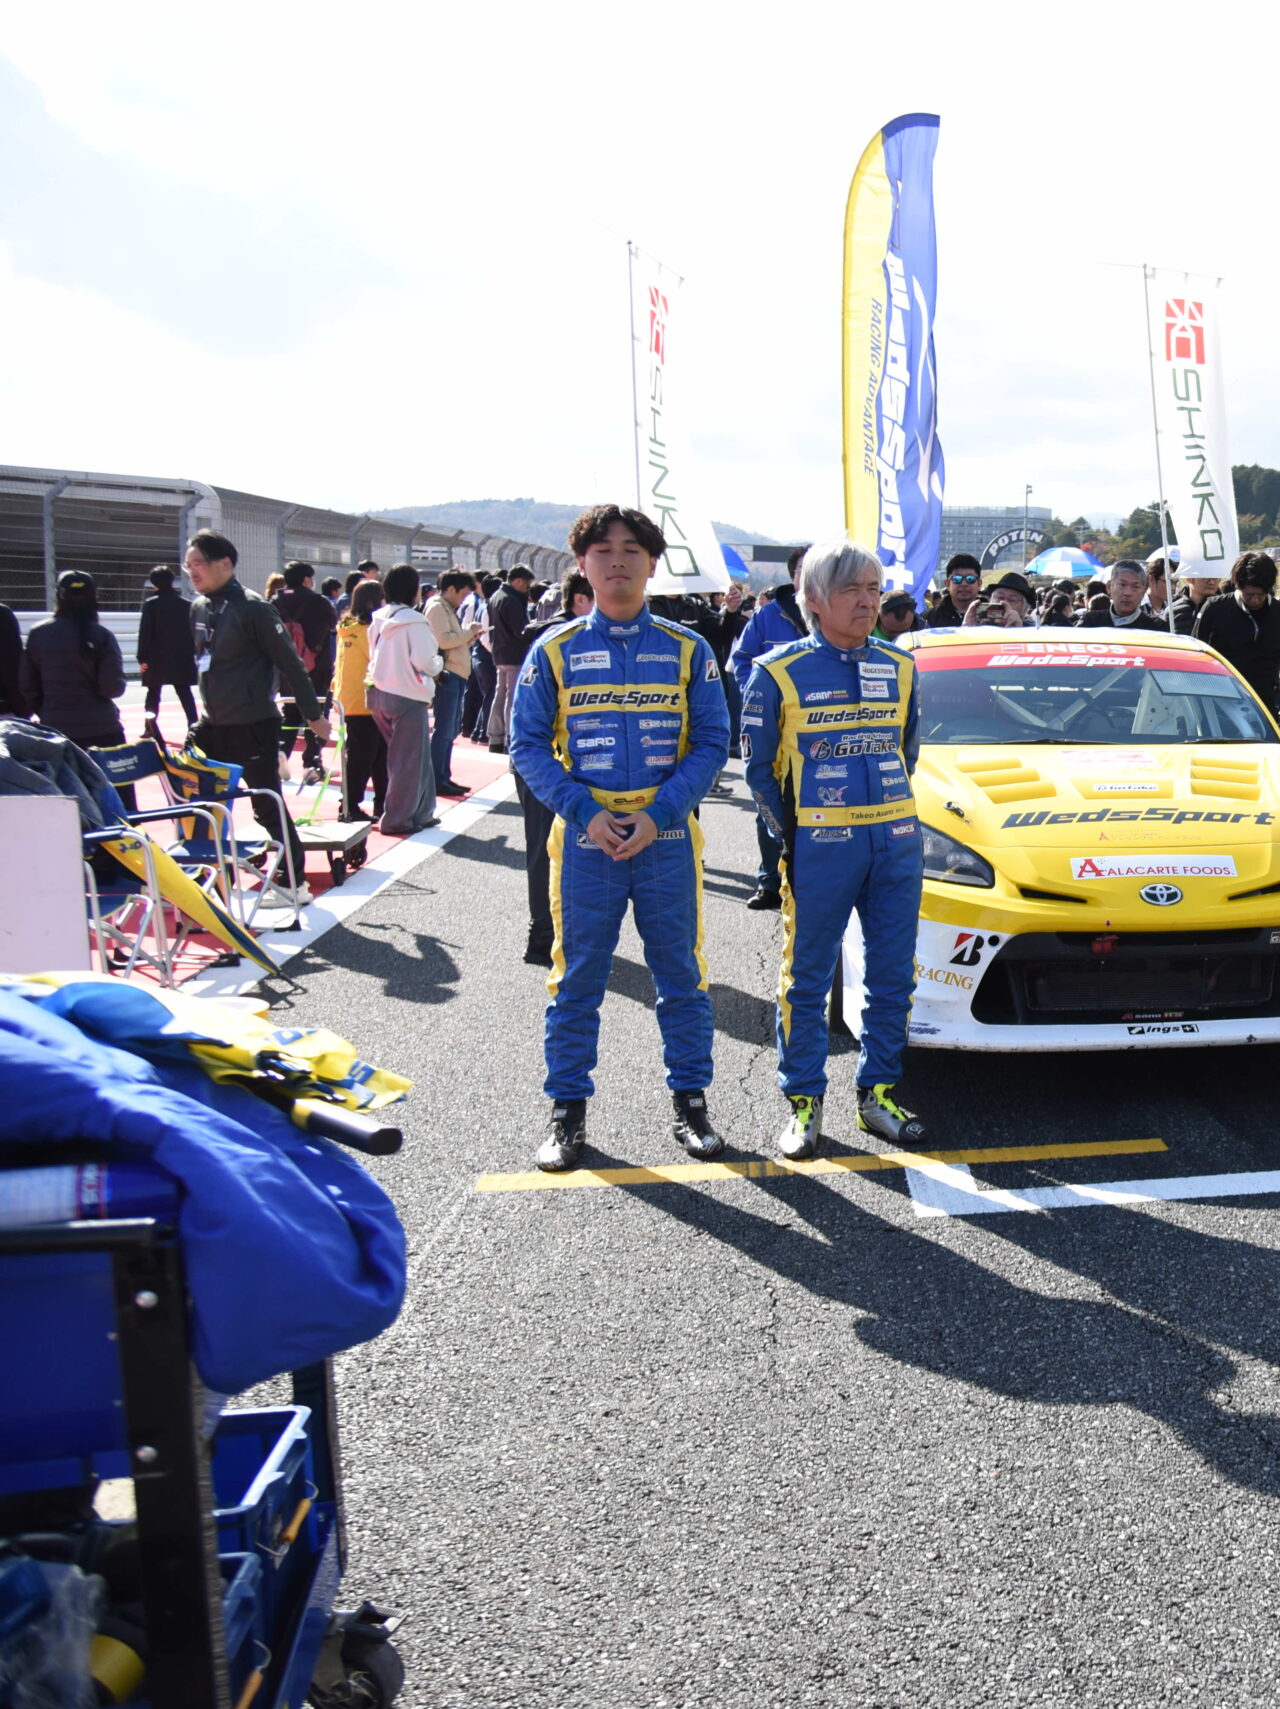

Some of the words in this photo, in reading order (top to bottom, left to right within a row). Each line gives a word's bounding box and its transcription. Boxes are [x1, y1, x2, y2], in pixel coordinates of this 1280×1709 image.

[870, 298, 883, 368] RACING
[862, 369, 879, 479] ADVANTAGE
[1172, 367, 1225, 562] SHINKO
[1023, 643, 1128, 655] ENEOS
[987, 655, 1146, 667] WedsSport
[568, 690, 681, 708] WedsSport
[806, 707, 898, 725] WedsSport
[834, 740, 897, 758] GoTake
[851, 811, 874, 820] Takeo
[1000, 807, 1276, 829] WedsSport
[1107, 866, 1180, 876] ALACARTE
[915, 963, 974, 990] RACING
